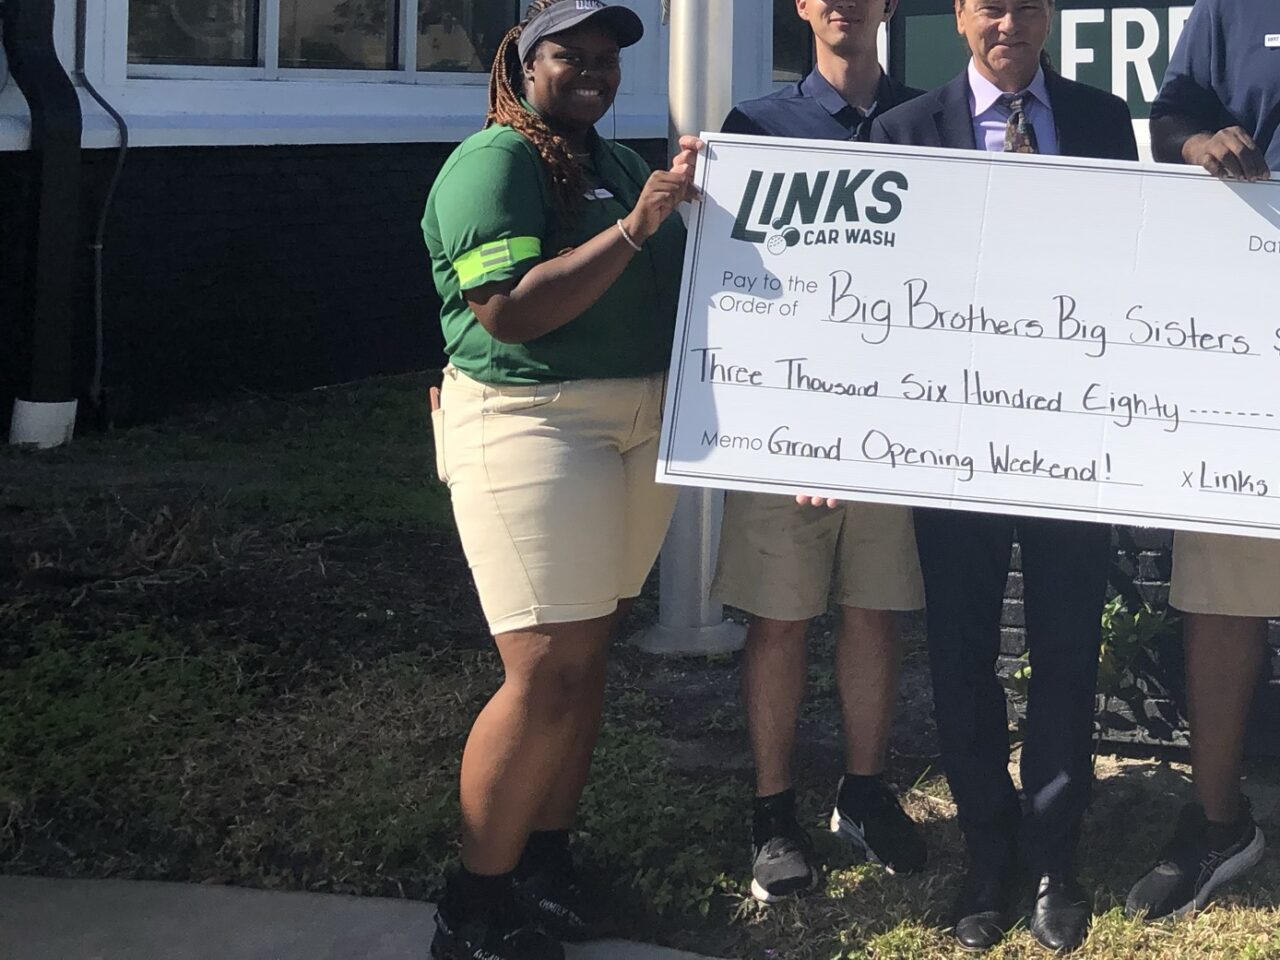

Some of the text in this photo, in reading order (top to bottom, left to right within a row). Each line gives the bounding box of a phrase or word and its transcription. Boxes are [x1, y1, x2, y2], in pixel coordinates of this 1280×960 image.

[730, 169, 908, 244] LINKS
[804, 228, 896, 248] CAR WASH
[722, 271, 818, 294] Pay to the
[719, 295, 799, 317] Order of
[828, 269, 1250, 358] Big Brothers Big Sisters
[690, 347, 763, 386] Three
[774, 357, 879, 398] Thousand
[900, 373, 948, 403] Six
[963, 369, 1062, 413] Hundred
[1082, 382, 1180, 433] Eighty
[700, 430, 763, 451] Memo
[768, 425, 1112, 483] Grand Opening Weekend!
[1199, 460, 1269, 497] Links
